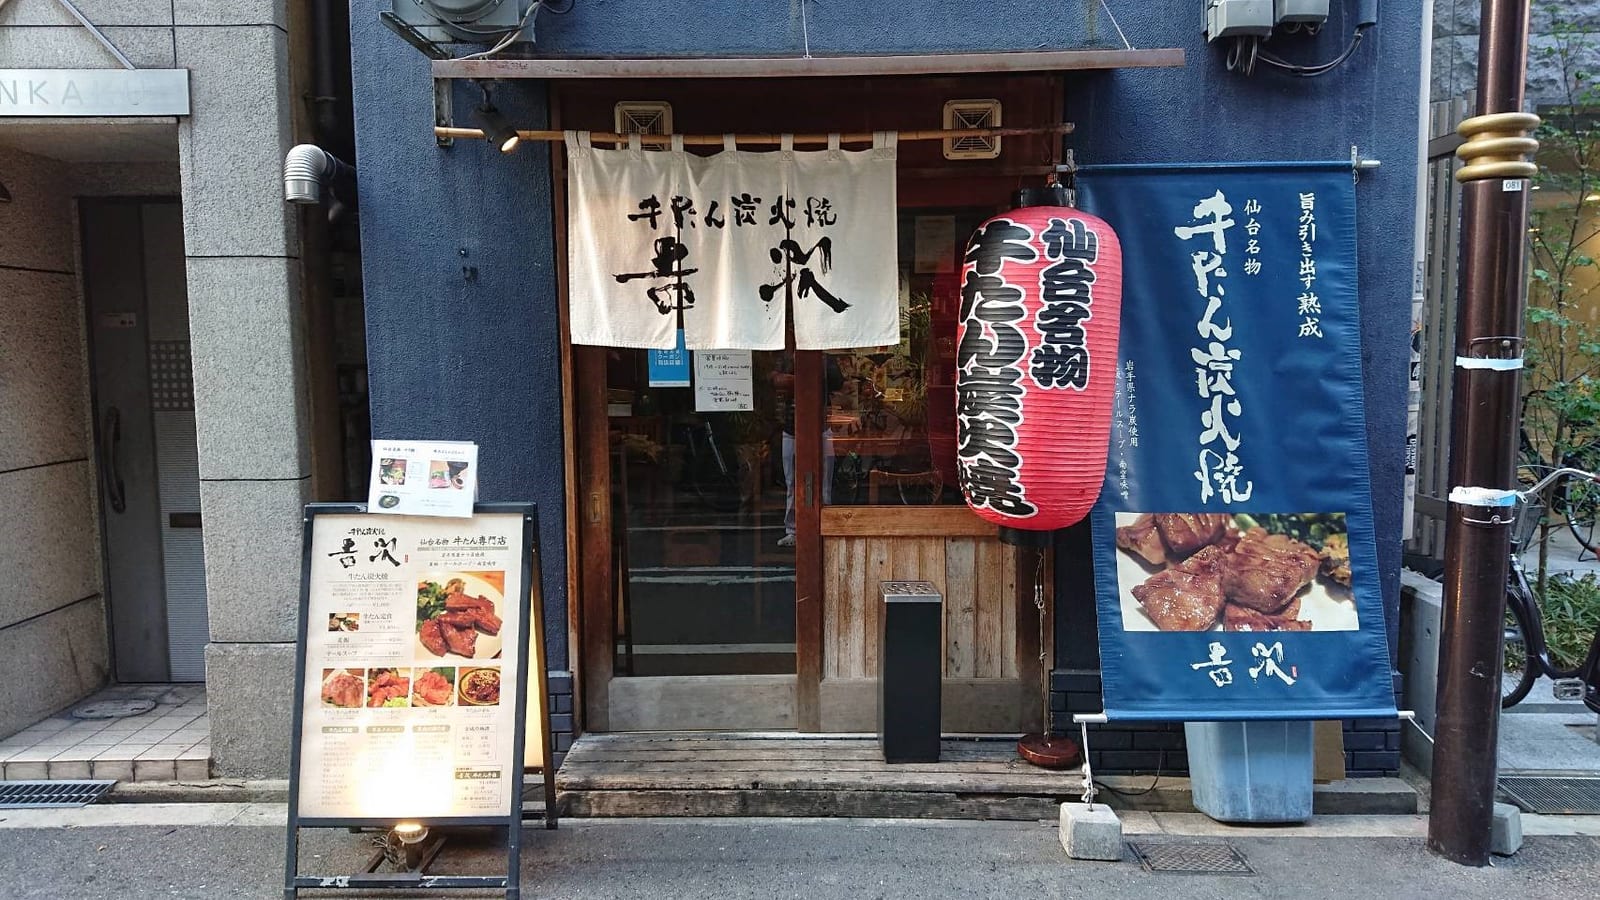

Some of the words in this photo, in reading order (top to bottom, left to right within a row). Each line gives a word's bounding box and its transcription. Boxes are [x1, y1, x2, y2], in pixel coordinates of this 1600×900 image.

[1244, 199, 1262, 276] 仙台名物
[1298, 193, 1323, 338] 旨み引き出す熟成
[1031, 217, 1098, 390] 仙台名物
[1125, 359, 1139, 447] 岩手県ナラ炭使用
[452, 535, 508, 546] 牛たん専門店
